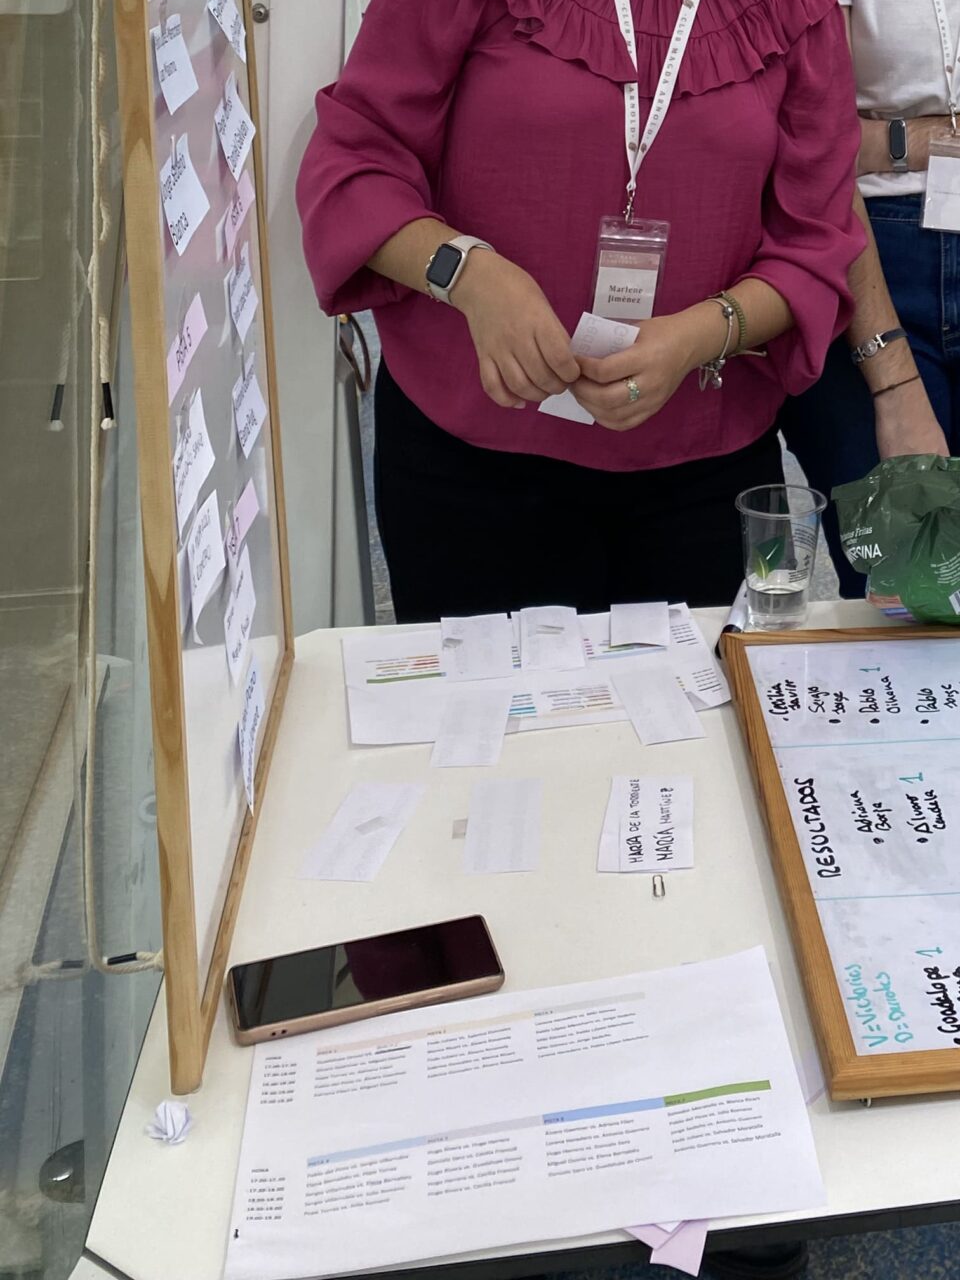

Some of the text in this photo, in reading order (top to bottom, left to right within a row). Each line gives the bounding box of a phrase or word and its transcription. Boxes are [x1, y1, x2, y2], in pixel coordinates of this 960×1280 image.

[609, 284, 643, 294] Marlene
[915, 687, 941, 715] Pablo
[629, 818, 641, 833] DE
[794, 777, 842, 879] RESULTADOS
